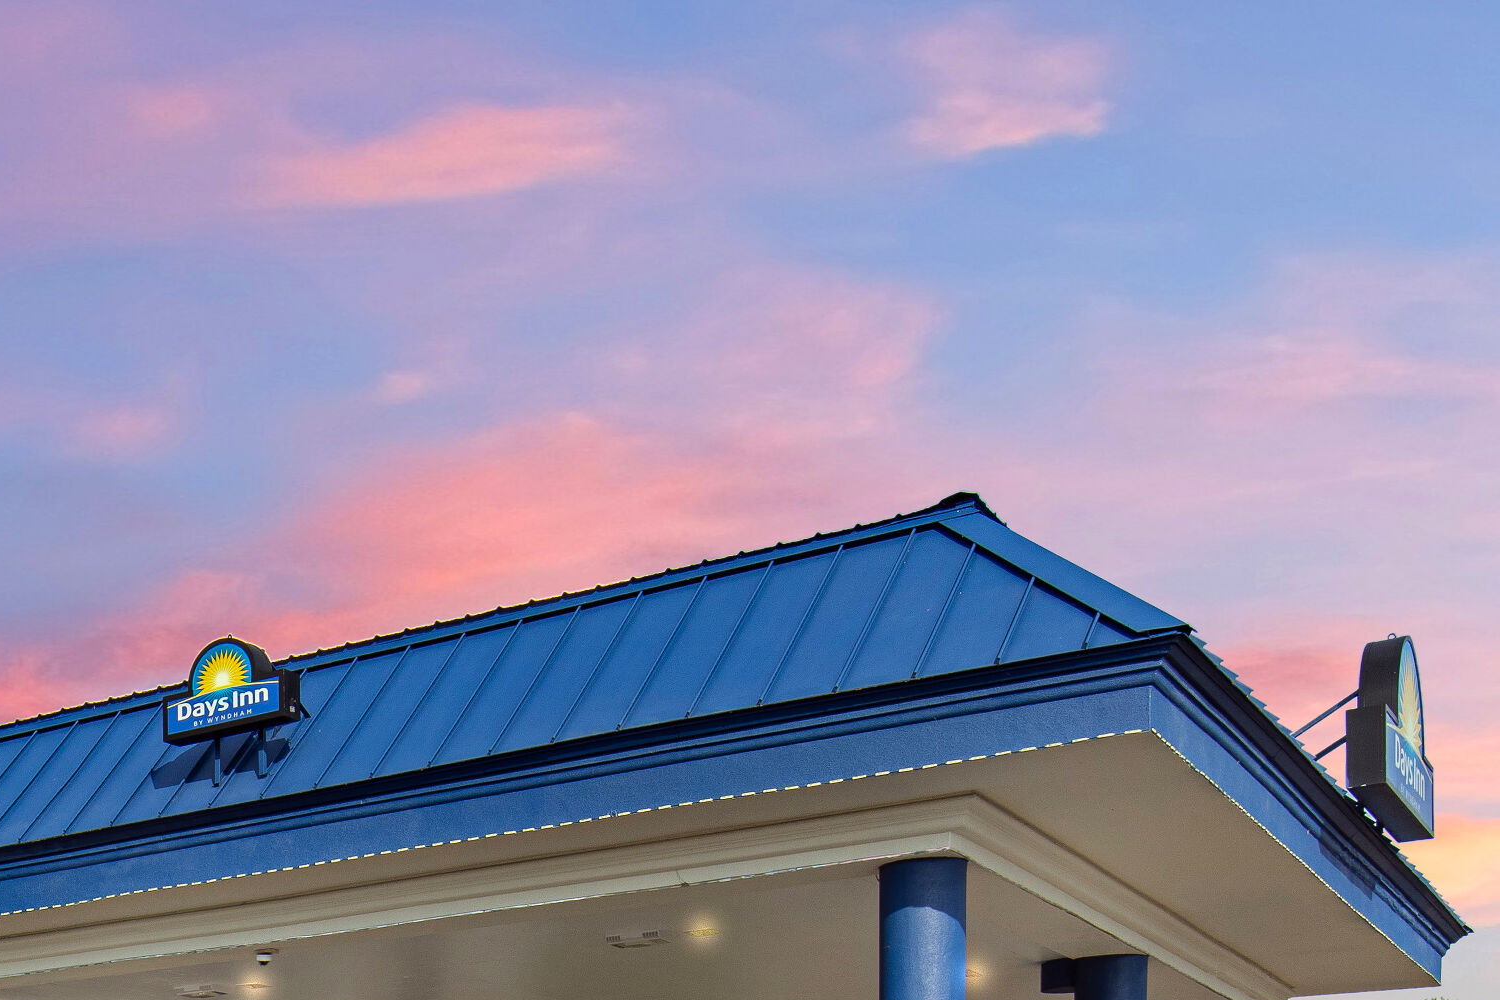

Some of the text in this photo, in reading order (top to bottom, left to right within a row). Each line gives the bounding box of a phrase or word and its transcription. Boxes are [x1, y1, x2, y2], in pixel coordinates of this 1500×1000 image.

[177, 687, 269, 721] Days Inn
[193, 708, 253, 727] BY WYNDHAM
[1395, 733, 1413, 785] Days
[1413, 757, 1425, 801] Inn
